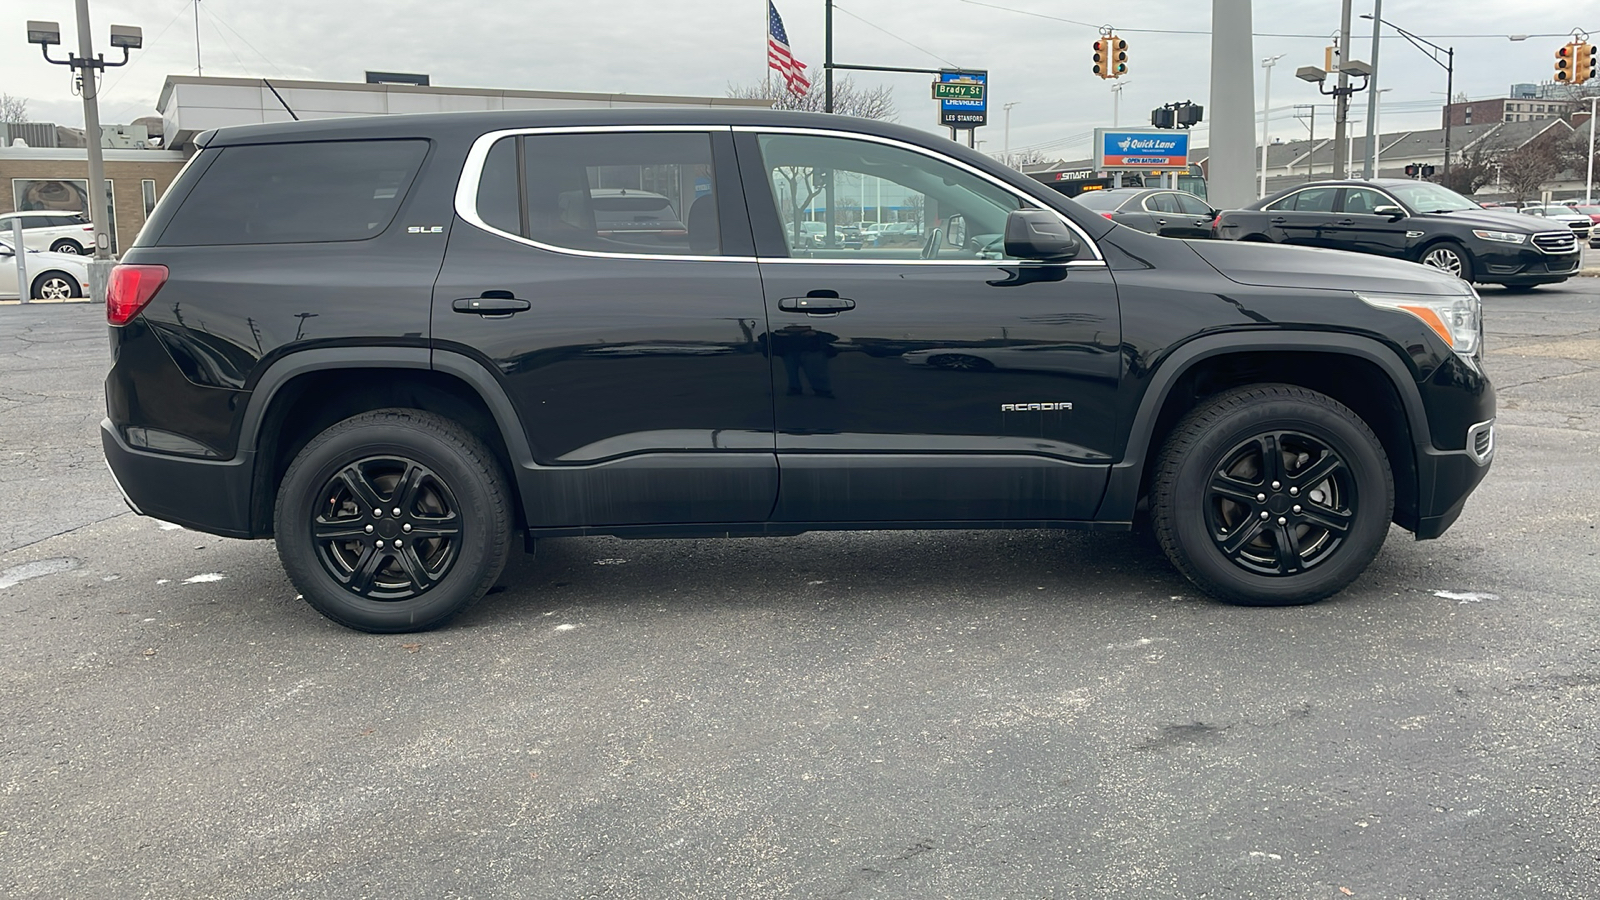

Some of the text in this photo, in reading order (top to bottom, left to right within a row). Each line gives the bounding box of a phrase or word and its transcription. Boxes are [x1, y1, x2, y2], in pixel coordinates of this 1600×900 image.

[940, 86, 966, 95] Brady
[1131, 140, 1176, 148] Quick Lane
[1060, 170, 1092, 180] SMART
[1002, 402, 1073, 412] ACADIA
